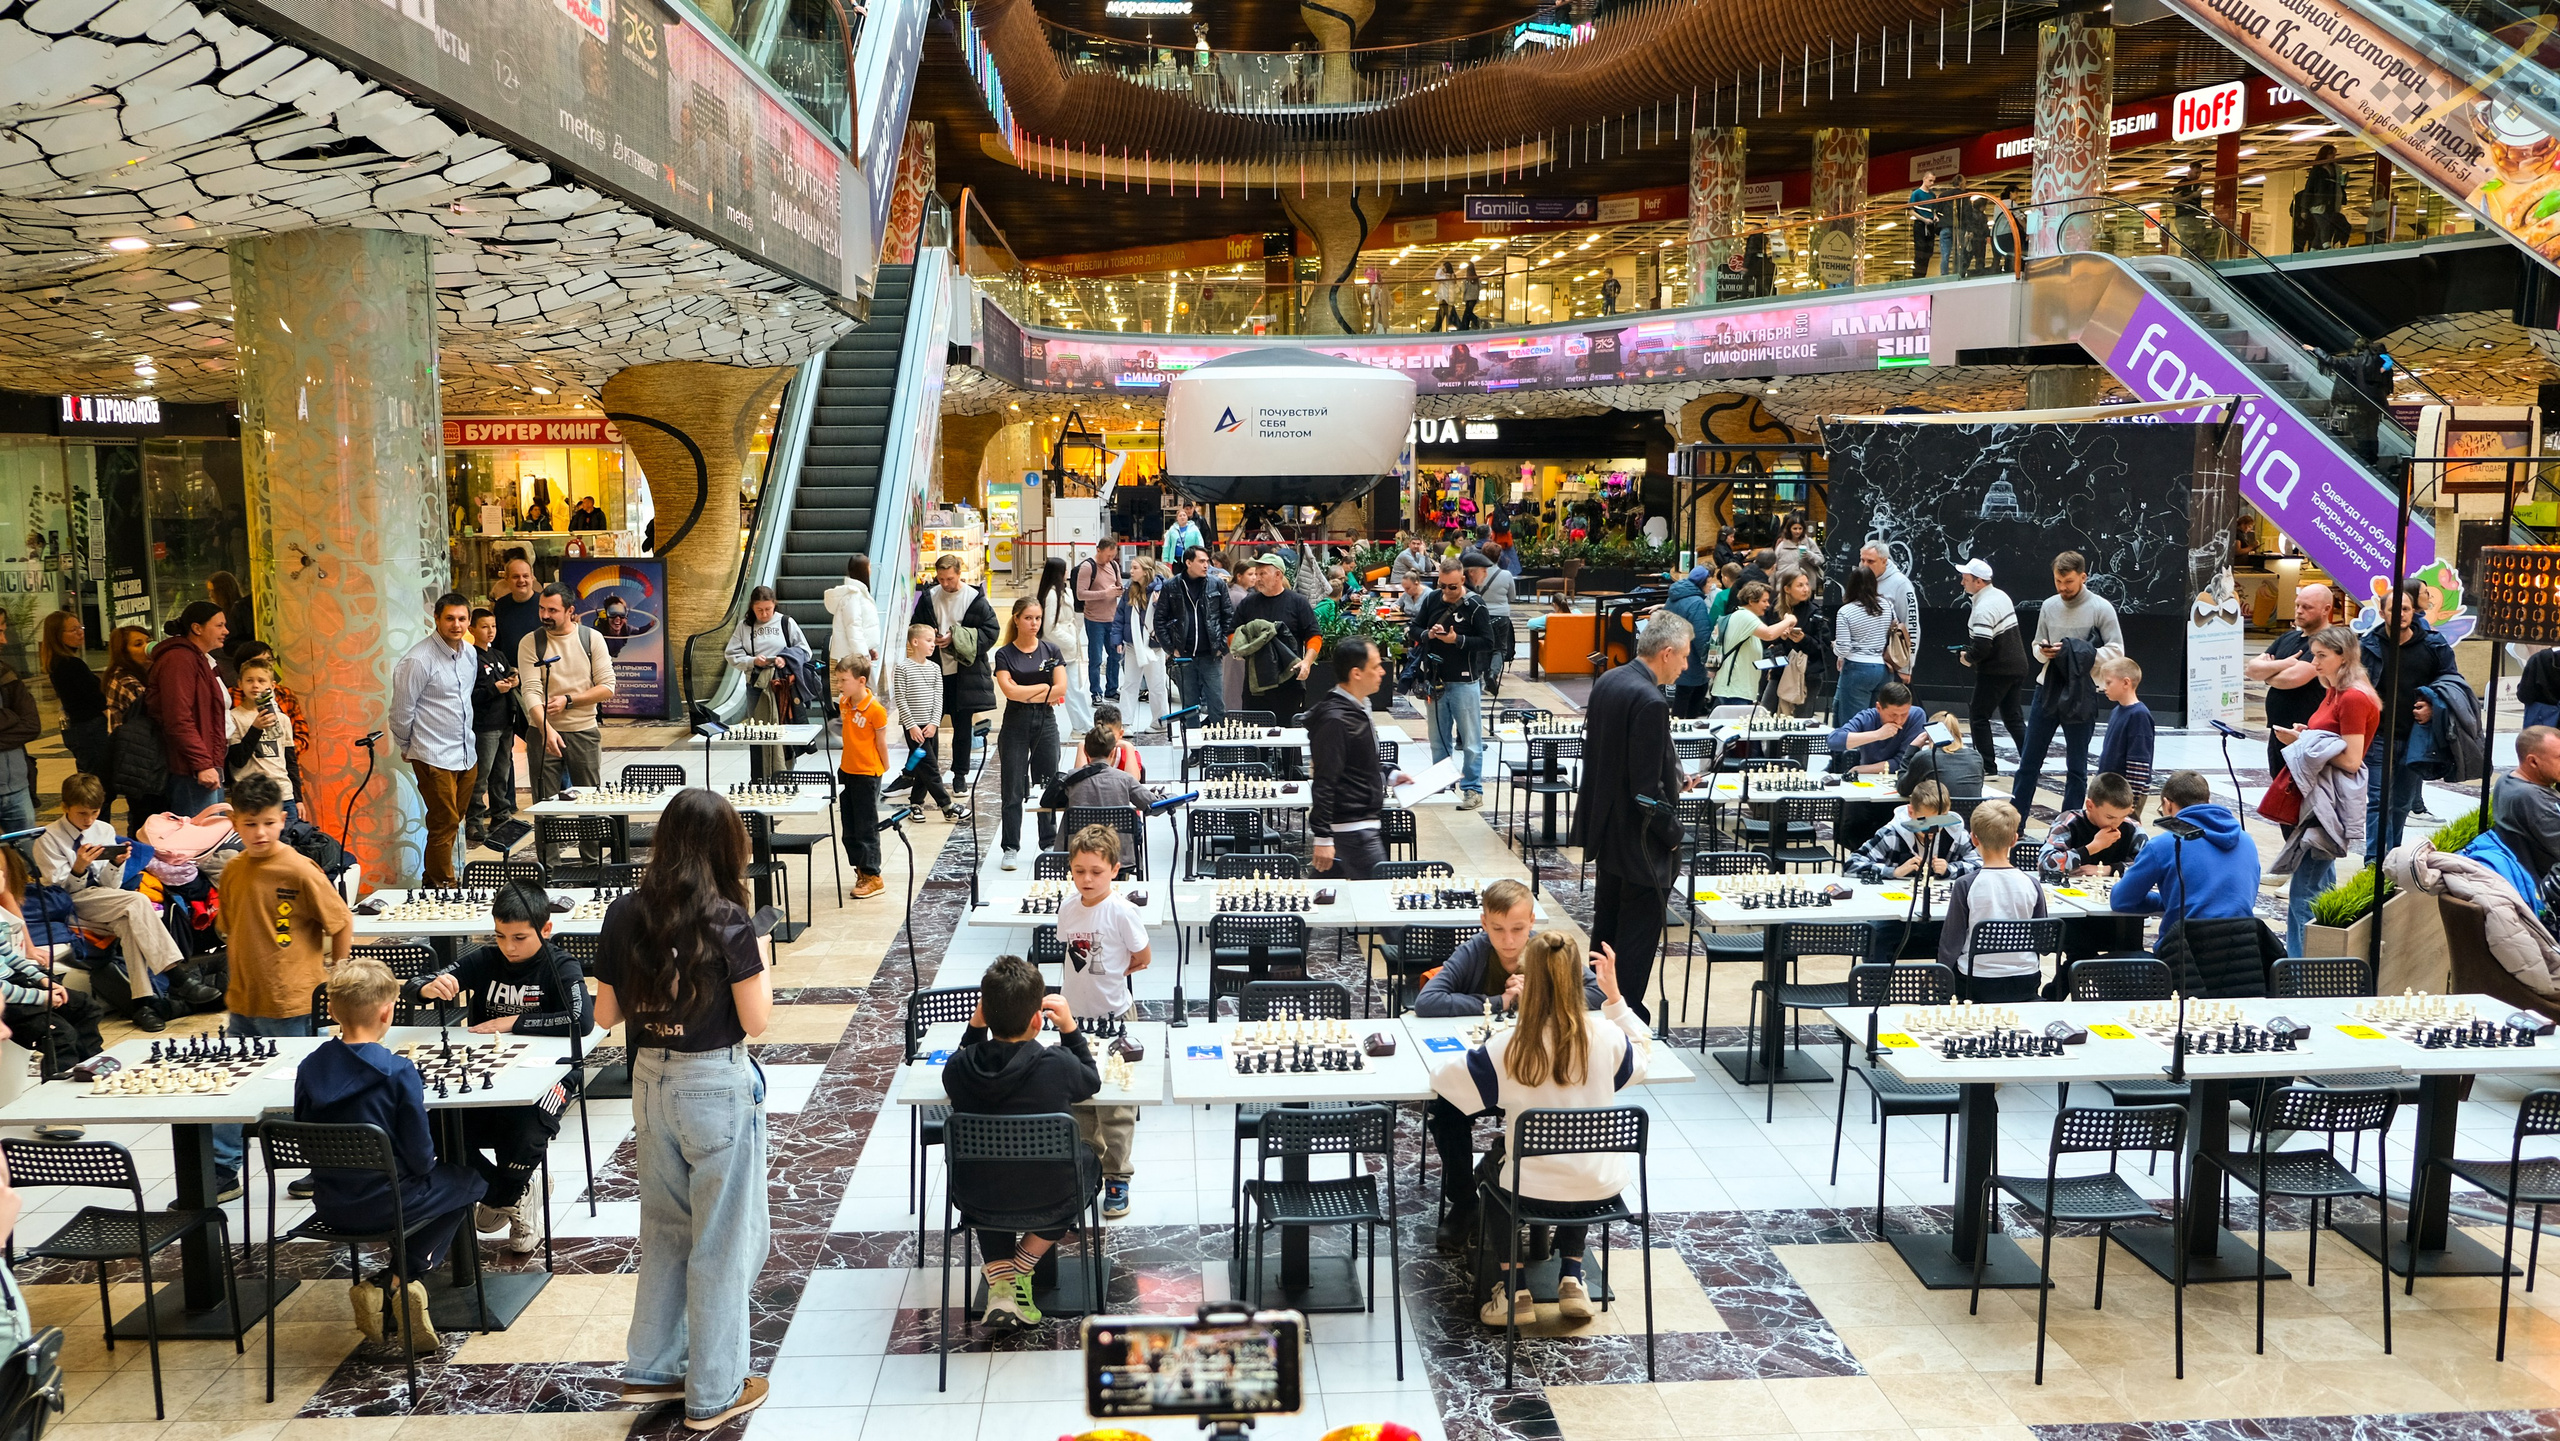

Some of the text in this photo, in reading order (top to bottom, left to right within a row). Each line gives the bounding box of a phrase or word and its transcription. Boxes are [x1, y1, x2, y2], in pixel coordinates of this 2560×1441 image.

[2269, 19, 2361, 99] Клаусс
[2329, 25, 2428, 93] ресторан
[494, 59, 521, 89] 12+
[2110, 112, 2157, 137] ЕБЕЛИ
[2179, 89, 2238, 135] Hoff
[2357, 99, 2388, 127] Резерв
[559, 108, 606, 151] metro
[1996, 137, 2035, 160] ГИПЕР
[2420, 117, 2485, 168] этаж
[2425, 145, 2472, 182] 777-15-51
[782, 152, 794, 186] 15
[796, 163, 834, 215] ОКТЯБРЯ
[727, 205, 754, 232] metro
[1475, 201, 1530, 215] familia
[1227, 239, 1252, 259] Hoff
[1074, 260, 1103, 272] МЕБЕЛИ
[1110, 255, 1144, 268] ТОВАРОВ
[1144, 253, 1161, 267] ДЛЯ
[1162, 252, 1186, 265] ДОМА
[1821, 261, 1851, 272] ТЕННИС
[1717, 326, 1792, 345] 15 ОКТЯБРЯ
[1795, 313, 1809, 338] 19:00
[1140, 358, 1154, 369] 15
[1703, 343, 1818, 365] СИМФОНИЧЕСКОЕ
[96, 396, 161, 424] ДРАКОНОВ
[1259, 406, 1328, 417] ПОЧУВСТВУЙ
[465, 423, 601, 441] БУРГЕР КИНГ
[1259, 419, 1286, 428] СЕБЯ
[1259, 430, 1312, 439] ПИЛОТОМ
[2310, 491, 2392, 569] Товары для дома
[2321, 482, 2396, 554] Одежда и обувь
[2311, 516, 2371, 572] Аксессуары
[5, 572, 53, 592] ССА
[1906, 592, 1917, 655] CATERPILLAR
[852, 711, 867, 728] 50
[486, 1001, 543, 1014] LEGEND
